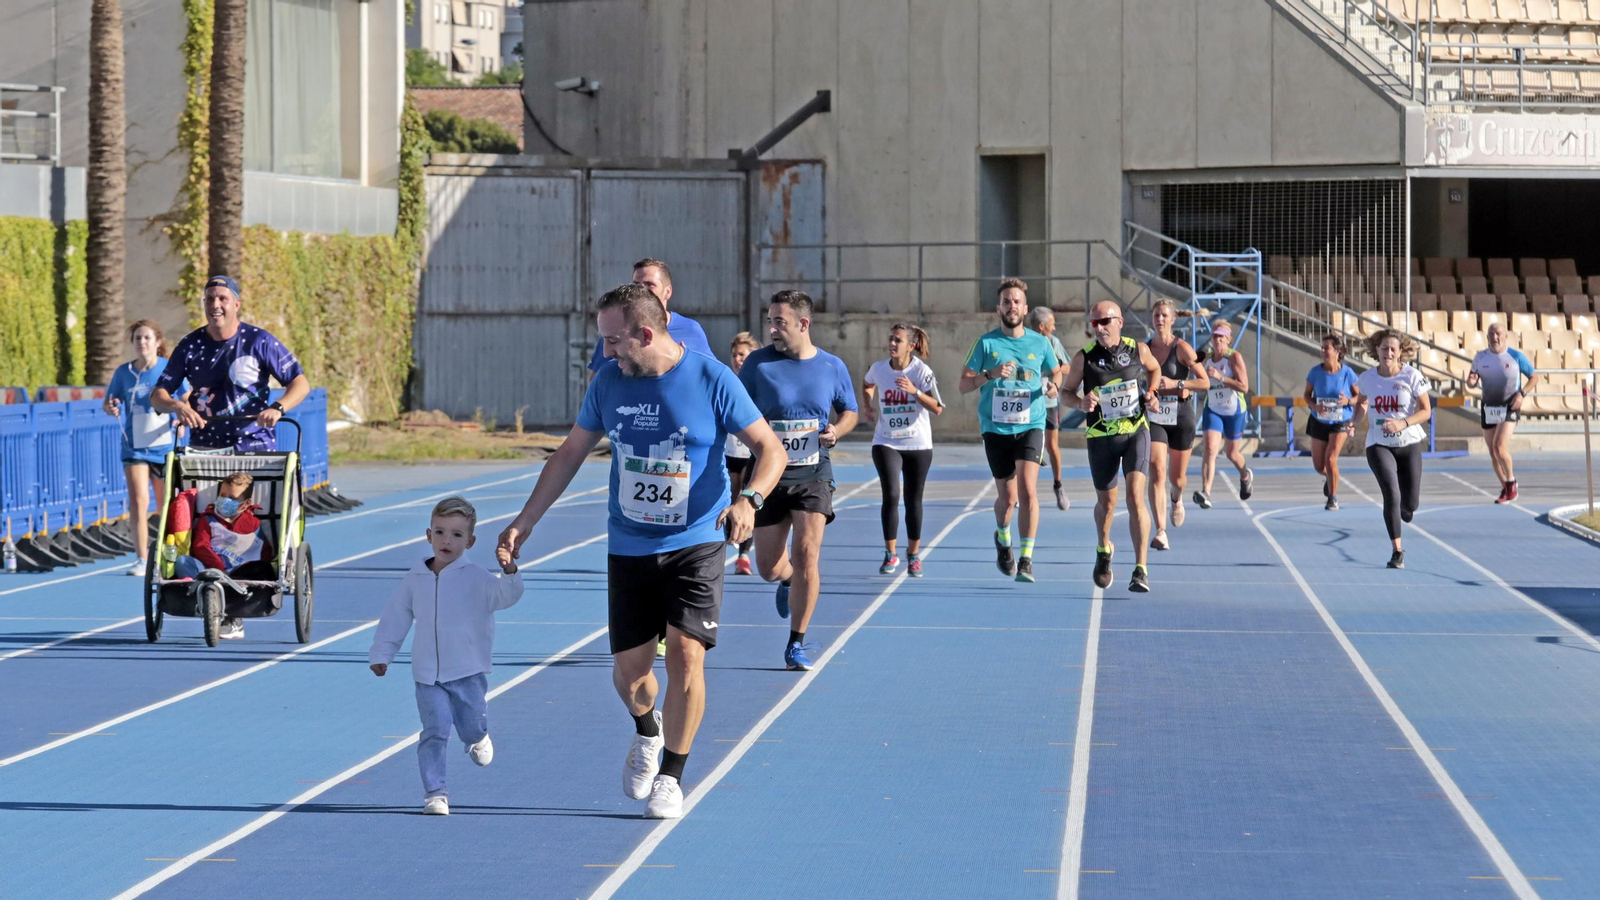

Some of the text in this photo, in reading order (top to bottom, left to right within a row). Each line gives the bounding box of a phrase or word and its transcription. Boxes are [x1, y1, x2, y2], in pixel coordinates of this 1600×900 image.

[1478, 118, 1600, 157] Cruzcam
[884, 389, 908, 406] RUN
[1110, 395, 1132, 408] 877
[1374, 395, 1399, 414] RUN
[636, 403, 660, 416] XLI
[1001, 402, 1023, 412] 878
[889, 417, 910, 428] 694
[782, 437, 809, 451] 507
[633, 481, 673, 505] 234
